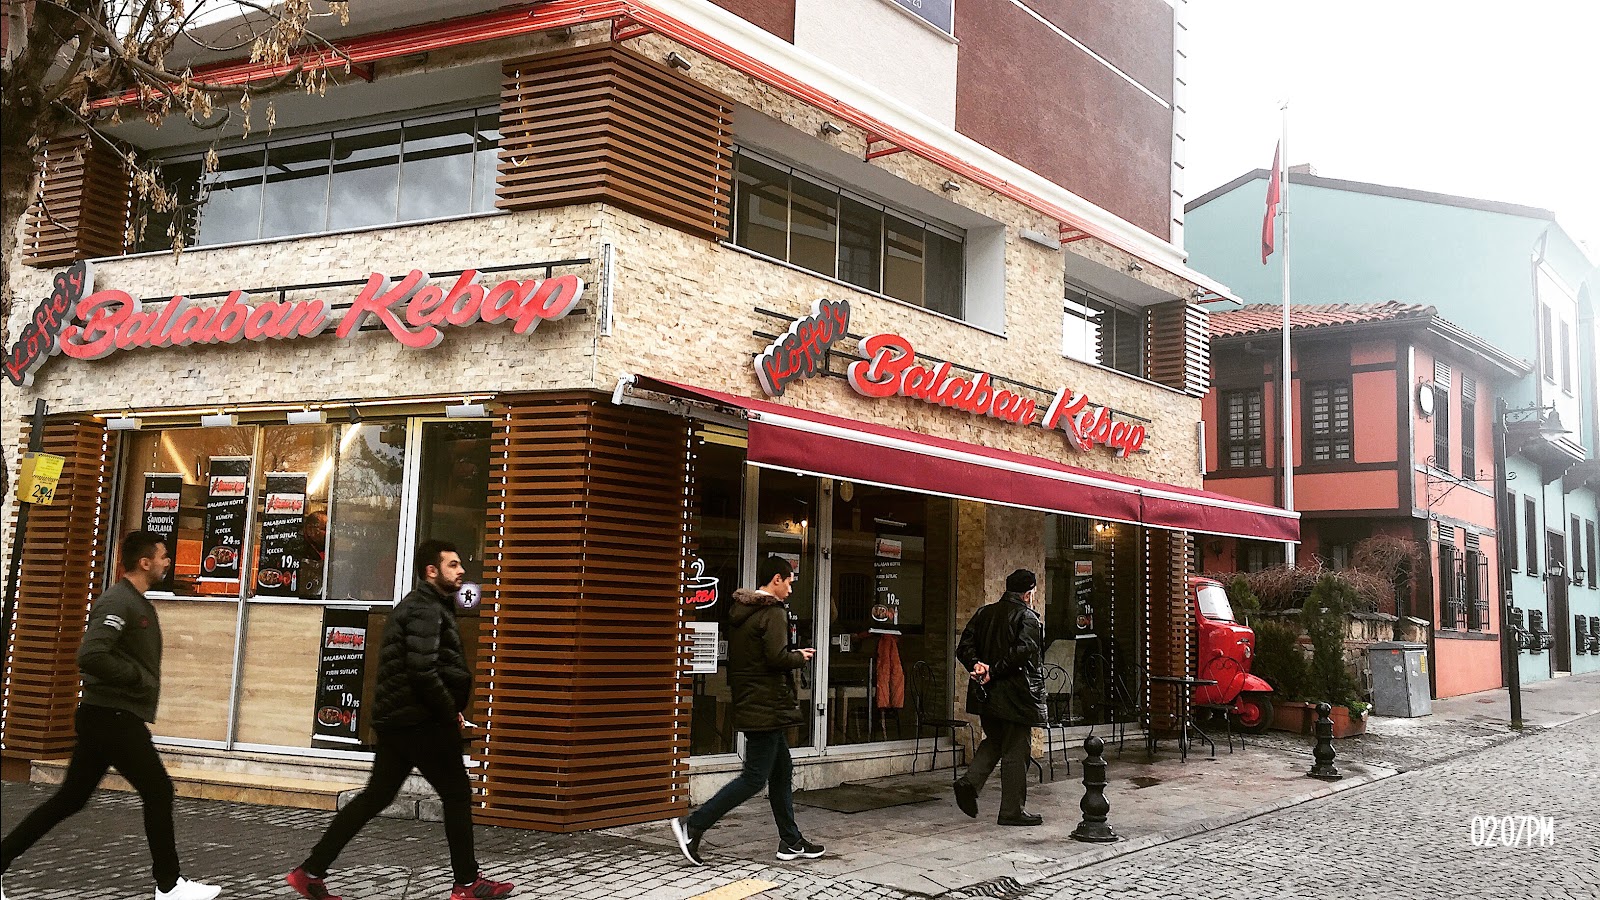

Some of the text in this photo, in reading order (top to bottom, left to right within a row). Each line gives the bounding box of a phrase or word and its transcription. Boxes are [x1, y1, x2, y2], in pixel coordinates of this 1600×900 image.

[60, 268, 582, 359] Balaban Kebap
[850, 334, 1146, 457] Balaban Kebap
